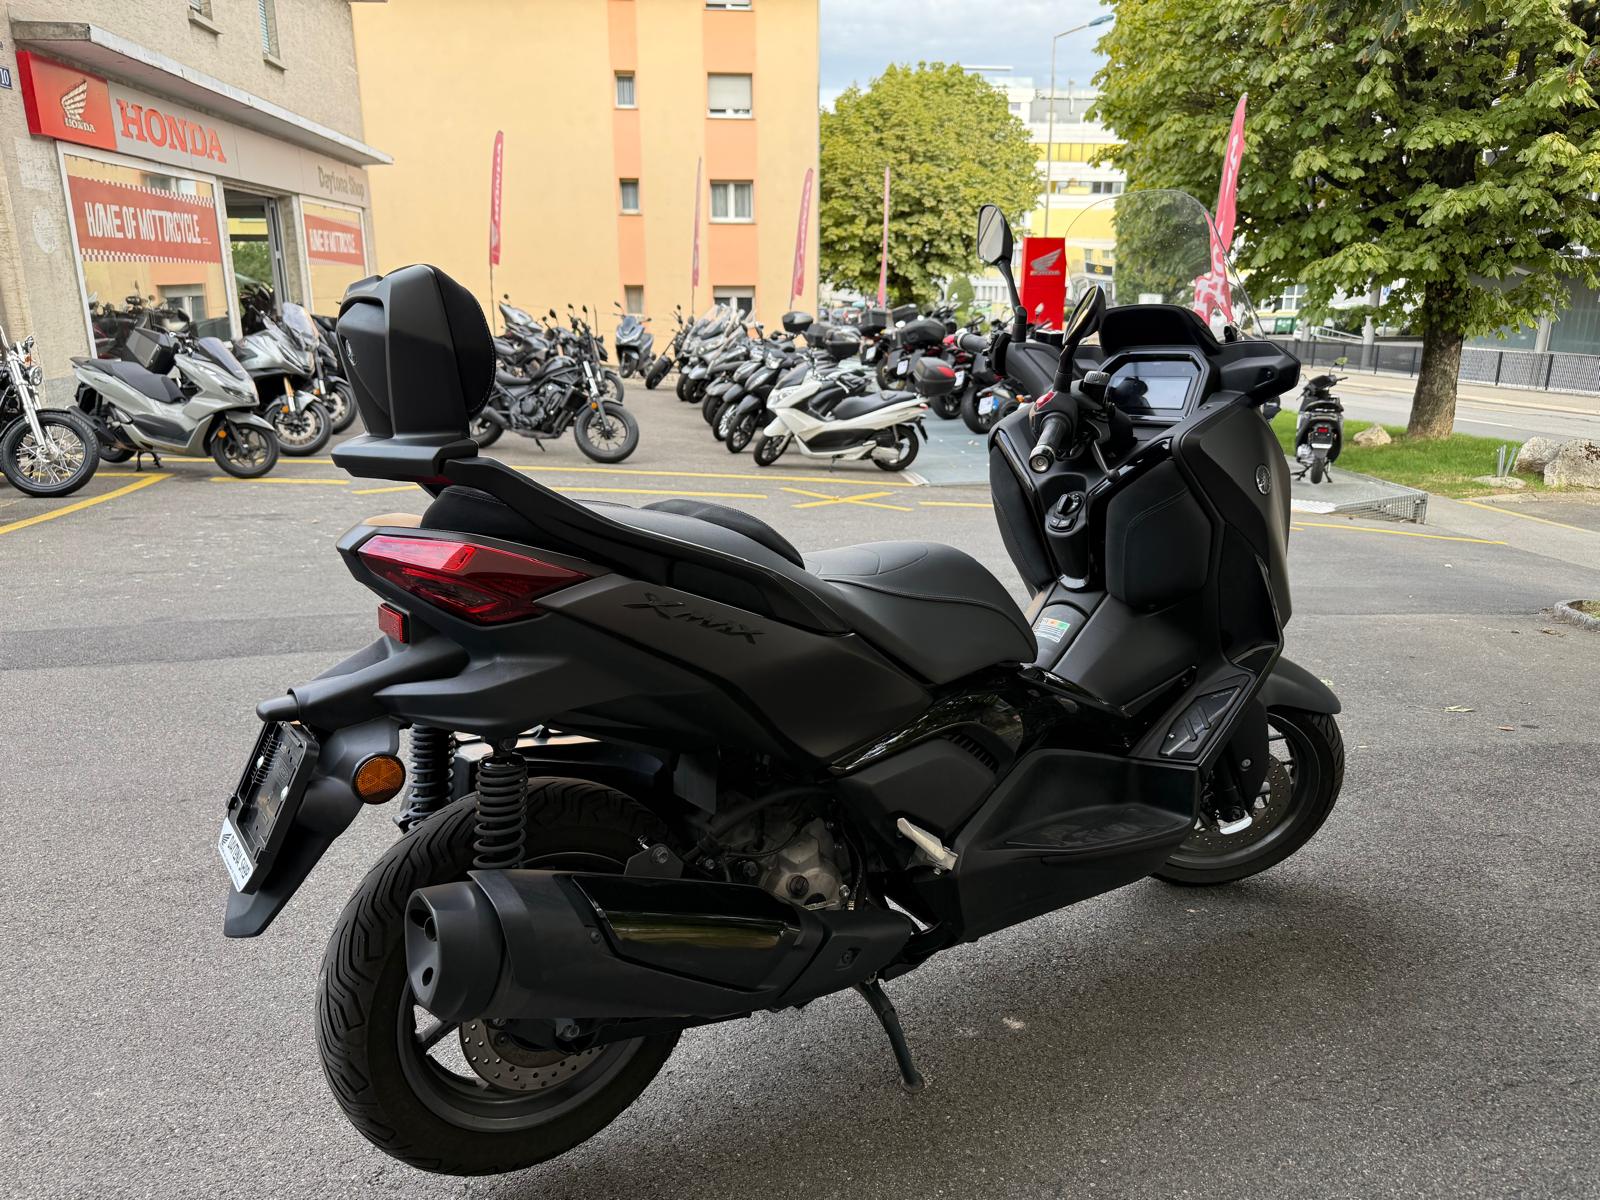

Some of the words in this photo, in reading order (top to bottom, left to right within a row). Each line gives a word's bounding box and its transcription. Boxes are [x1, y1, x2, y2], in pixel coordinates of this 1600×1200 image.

[65, 118, 96, 133] HONDA
[116, 98, 227, 163] HONDA
[318, 165, 349, 194] Daytona
[349, 175, 365, 201] Shop
[122, 206, 136, 240] OF
